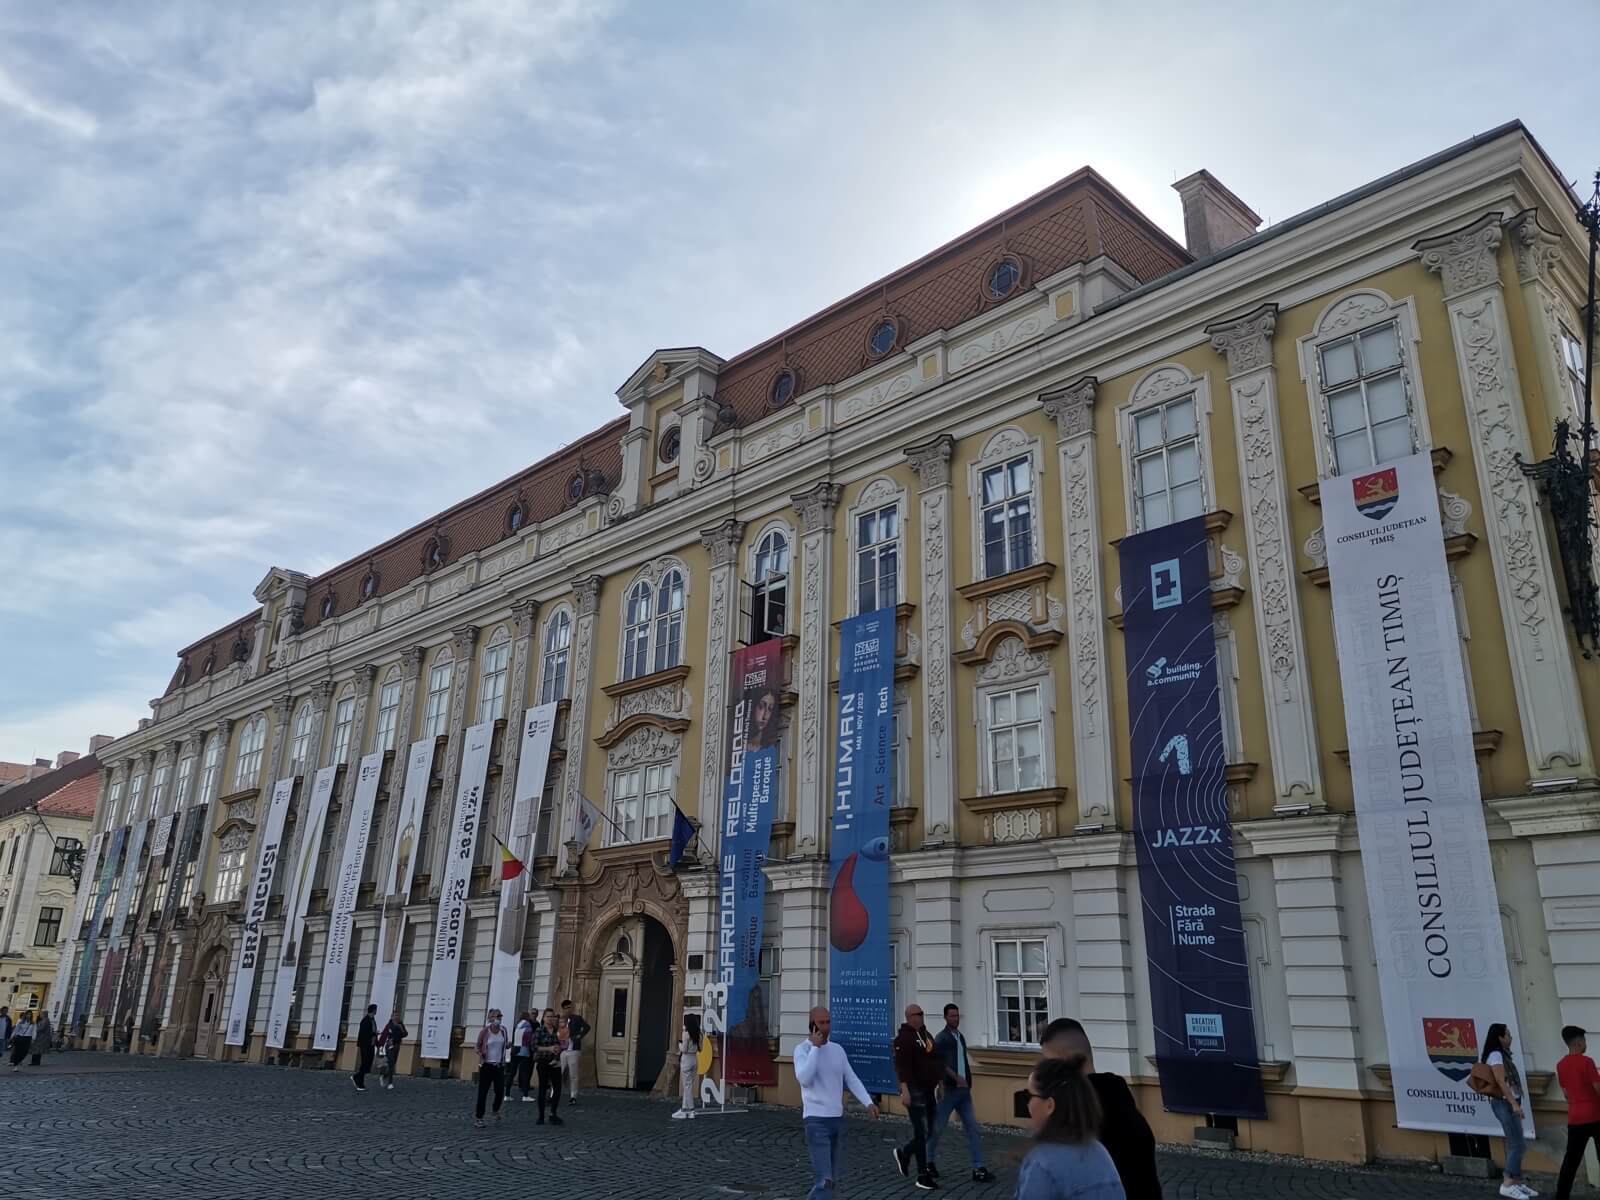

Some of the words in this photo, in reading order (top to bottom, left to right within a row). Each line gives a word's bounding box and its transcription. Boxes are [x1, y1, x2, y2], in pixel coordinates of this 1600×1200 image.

[1336, 526, 1382, 544] CONSILIUL
[877, 686, 889, 717] Tech
[875, 725, 887, 775] Science
[726, 700, 745, 837] RELOADED
[760, 756, 772, 803] Baroque
[874, 784, 885, 806] Art
[1407, 810, 1452, 979] CONSILIUL
[1175, 904, 1216, 918] Strada
[1177, 917, 1205, 932] Fără
[1178, 933, 1216, 946] Nume
[1407, 1088, 1460, 1101] CONSILIUL
